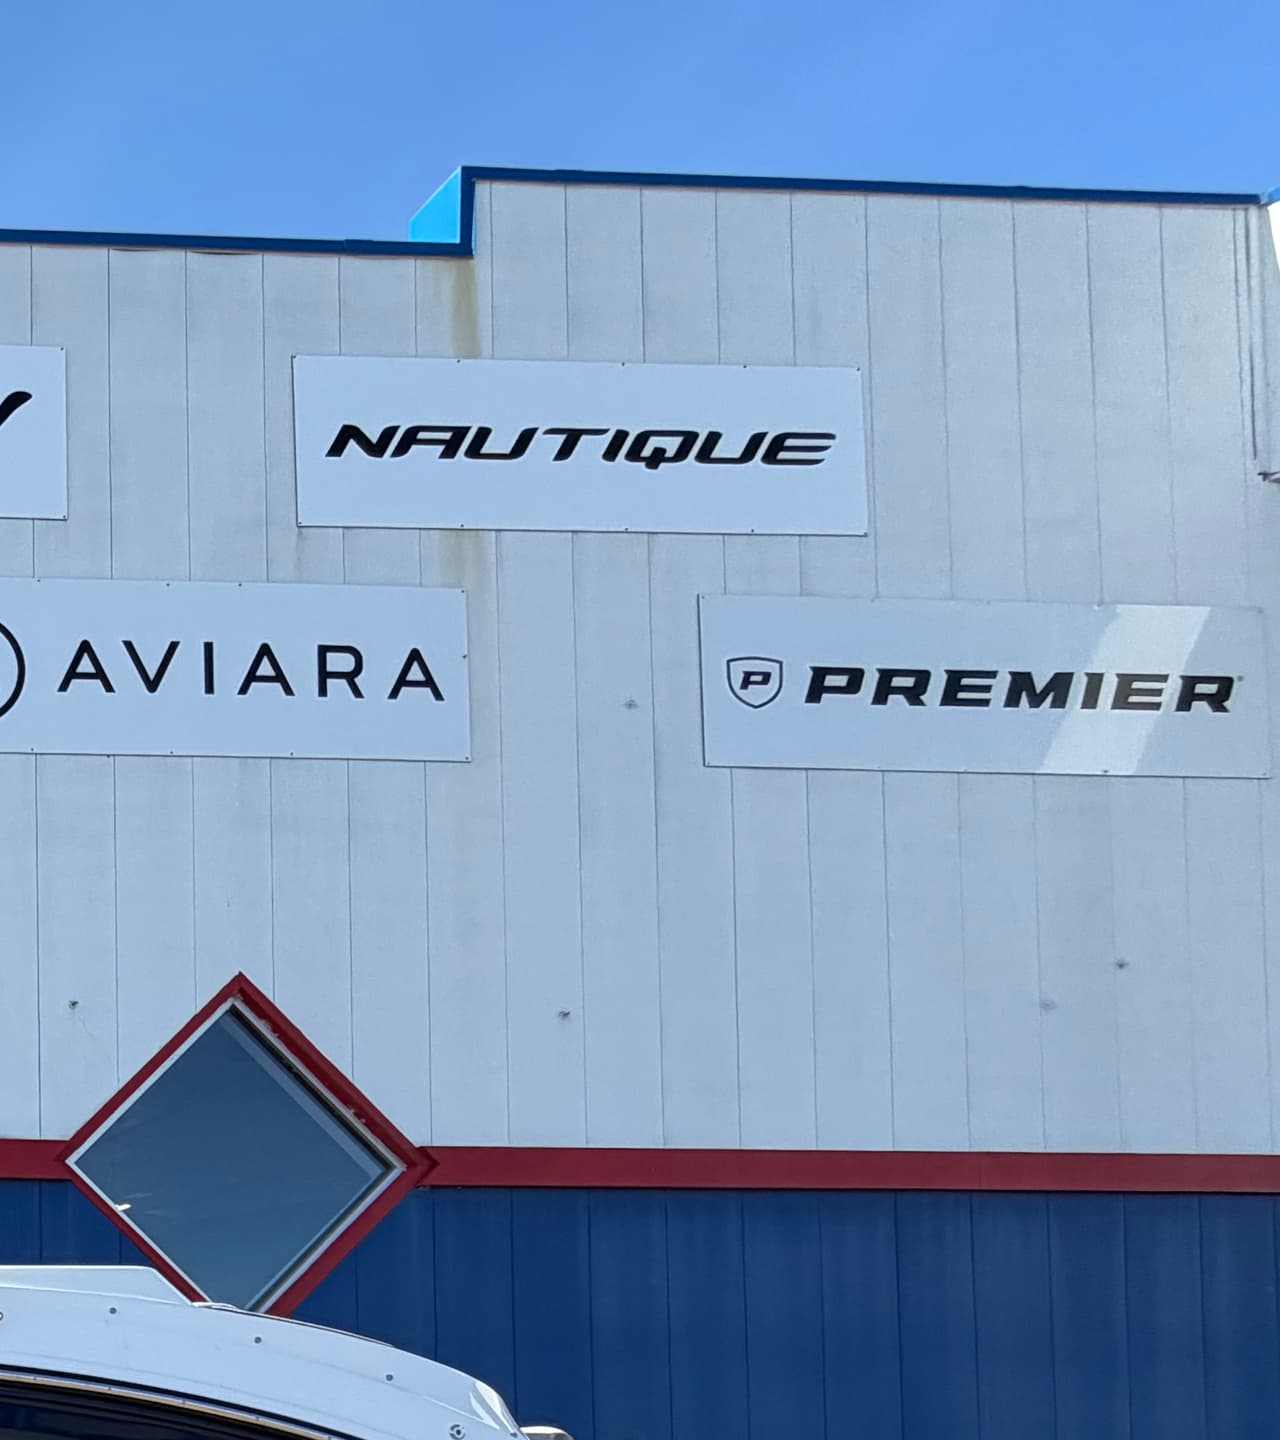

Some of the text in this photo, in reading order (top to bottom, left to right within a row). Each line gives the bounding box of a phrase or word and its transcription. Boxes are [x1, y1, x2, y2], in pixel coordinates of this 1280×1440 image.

[325, 424, 838, 470] NAUTIQUE
[57, 639, 446, 702] AVIARA
[739, 665, 1235, 714] P PREMIER
